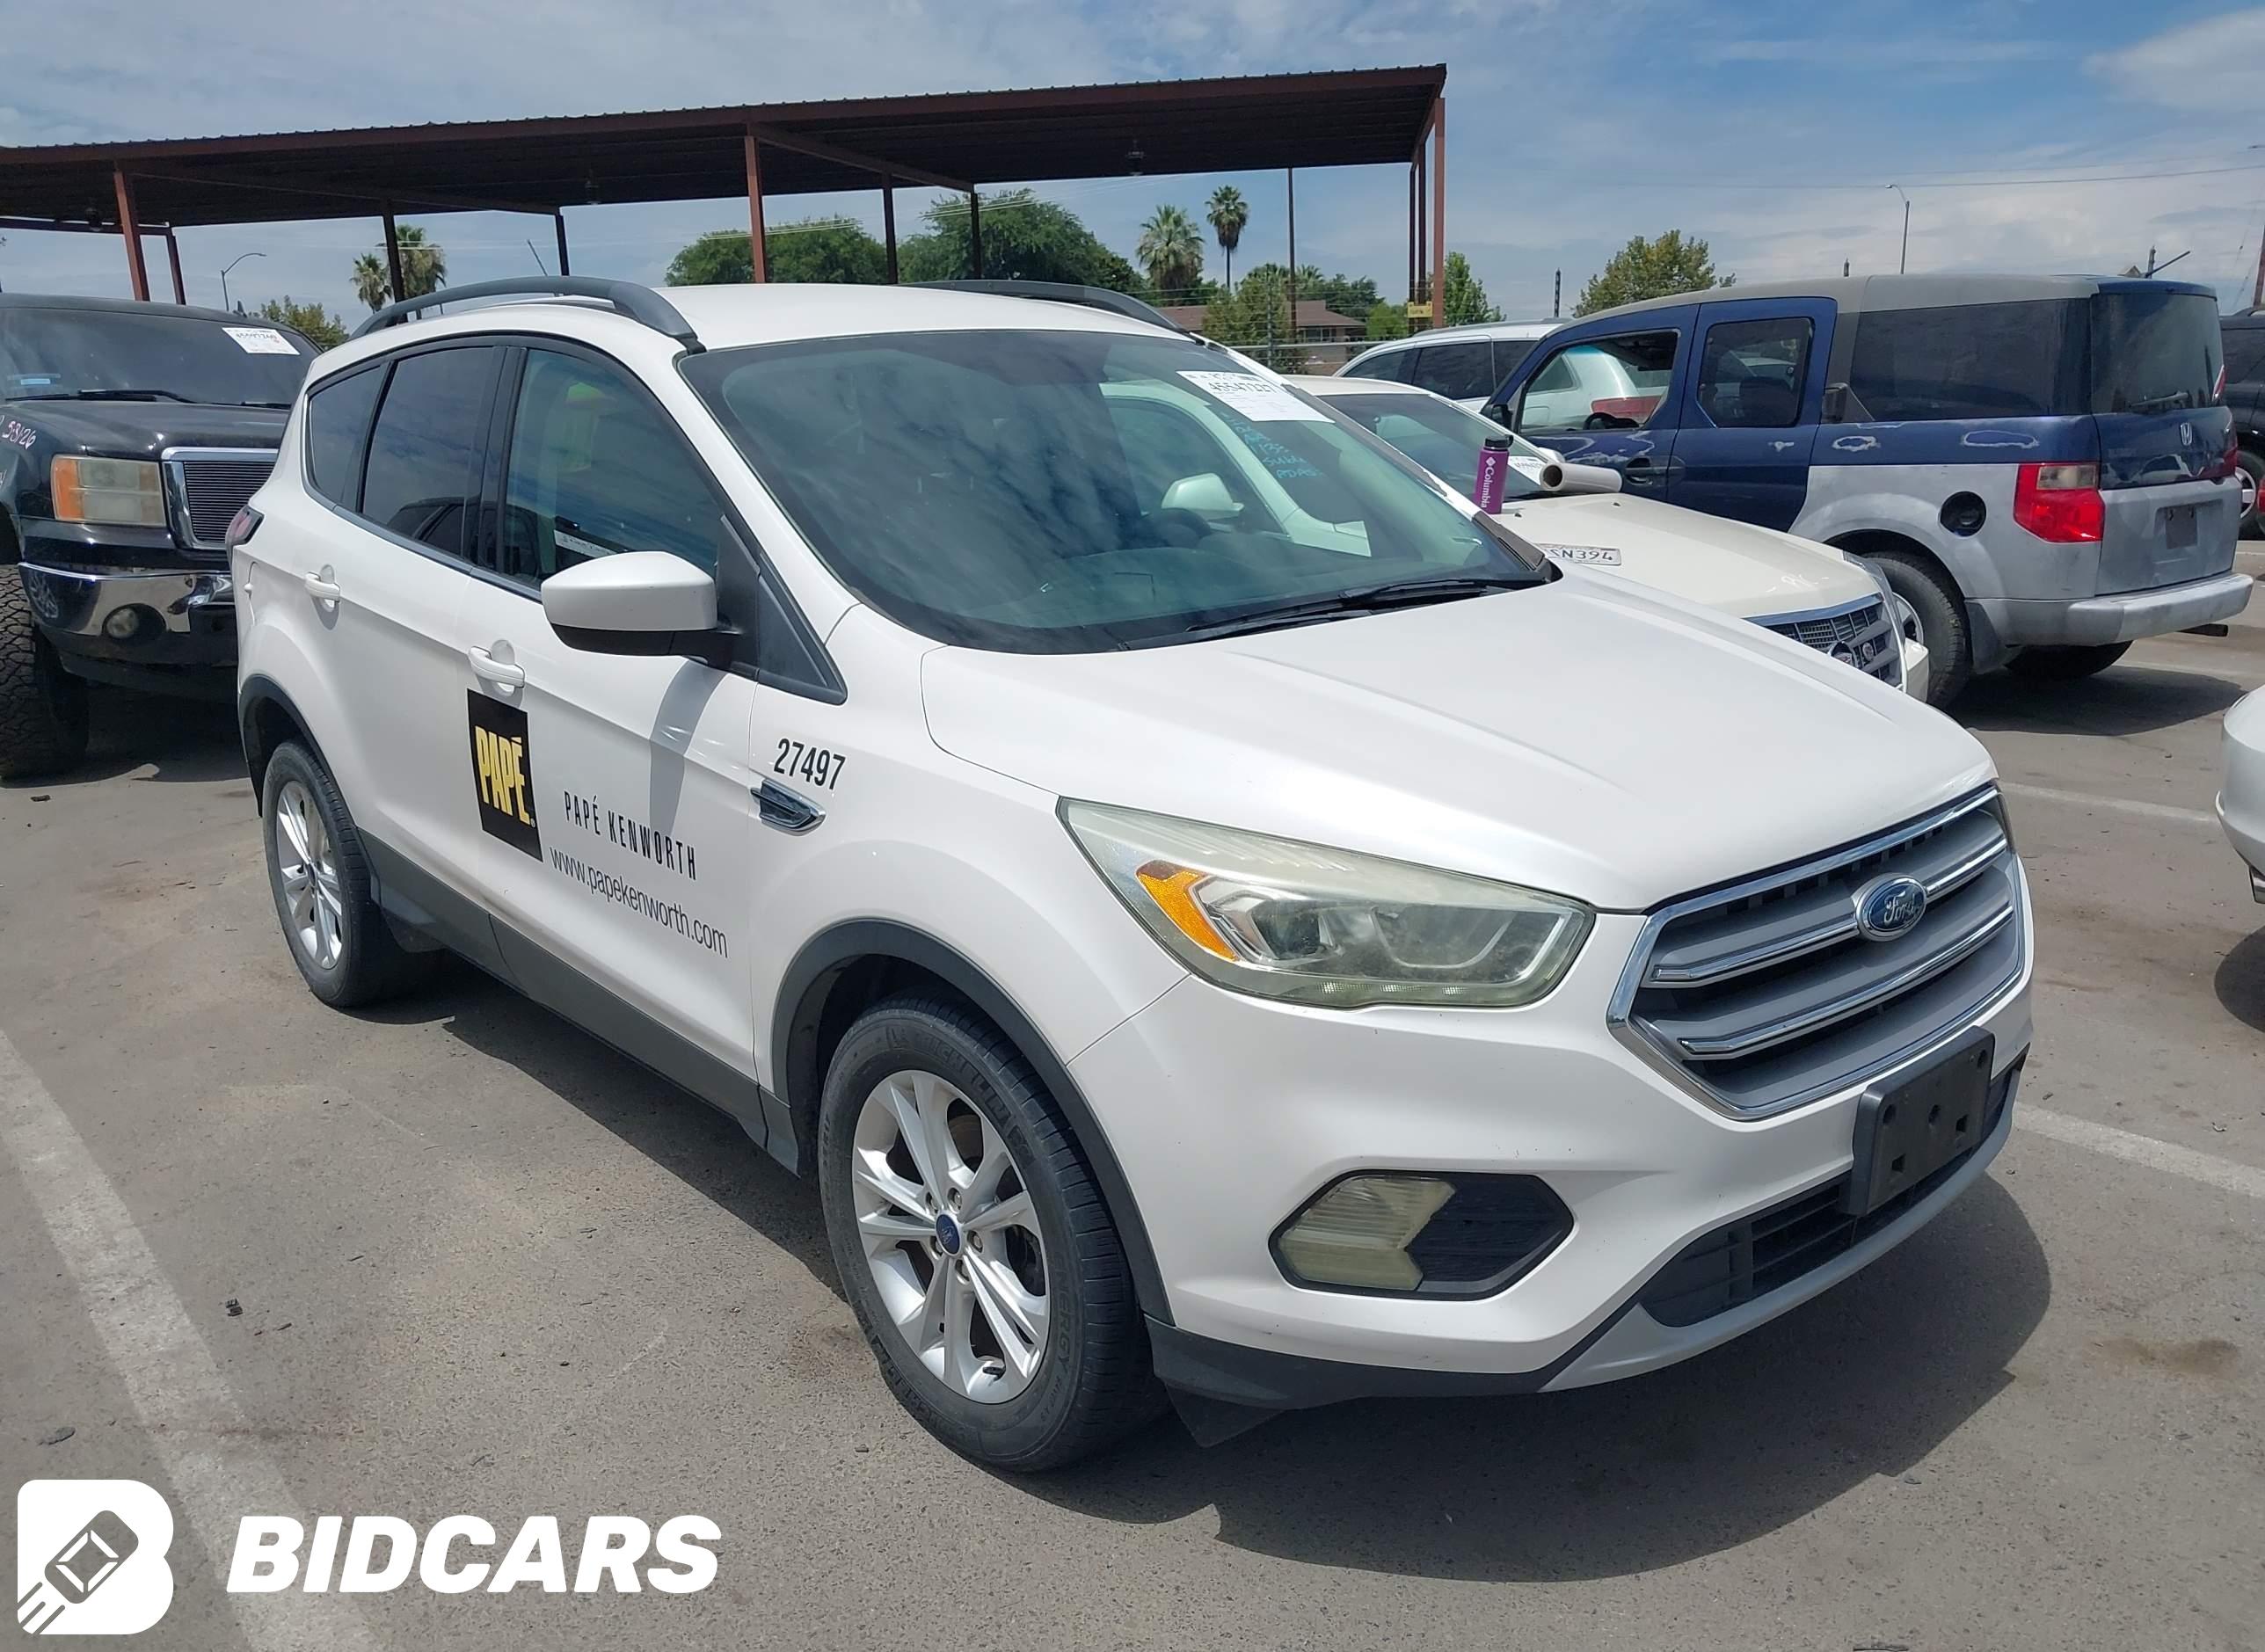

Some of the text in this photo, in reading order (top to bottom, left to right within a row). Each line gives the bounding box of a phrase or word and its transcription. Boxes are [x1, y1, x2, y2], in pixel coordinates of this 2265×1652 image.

[1481, 467, 1495, 509] Columbia
[475, 724, 531, 826] PAPÉ
[773, 738, 847, 791] 27497
[564, 790, 697, 880] PAPÉ KENWORTH
[549, 846, 730, 958] www.papekenworth.com
[1883, 891, 1915, 926] Ford
[1053, 1250, 1071, 1373] ENERGY
